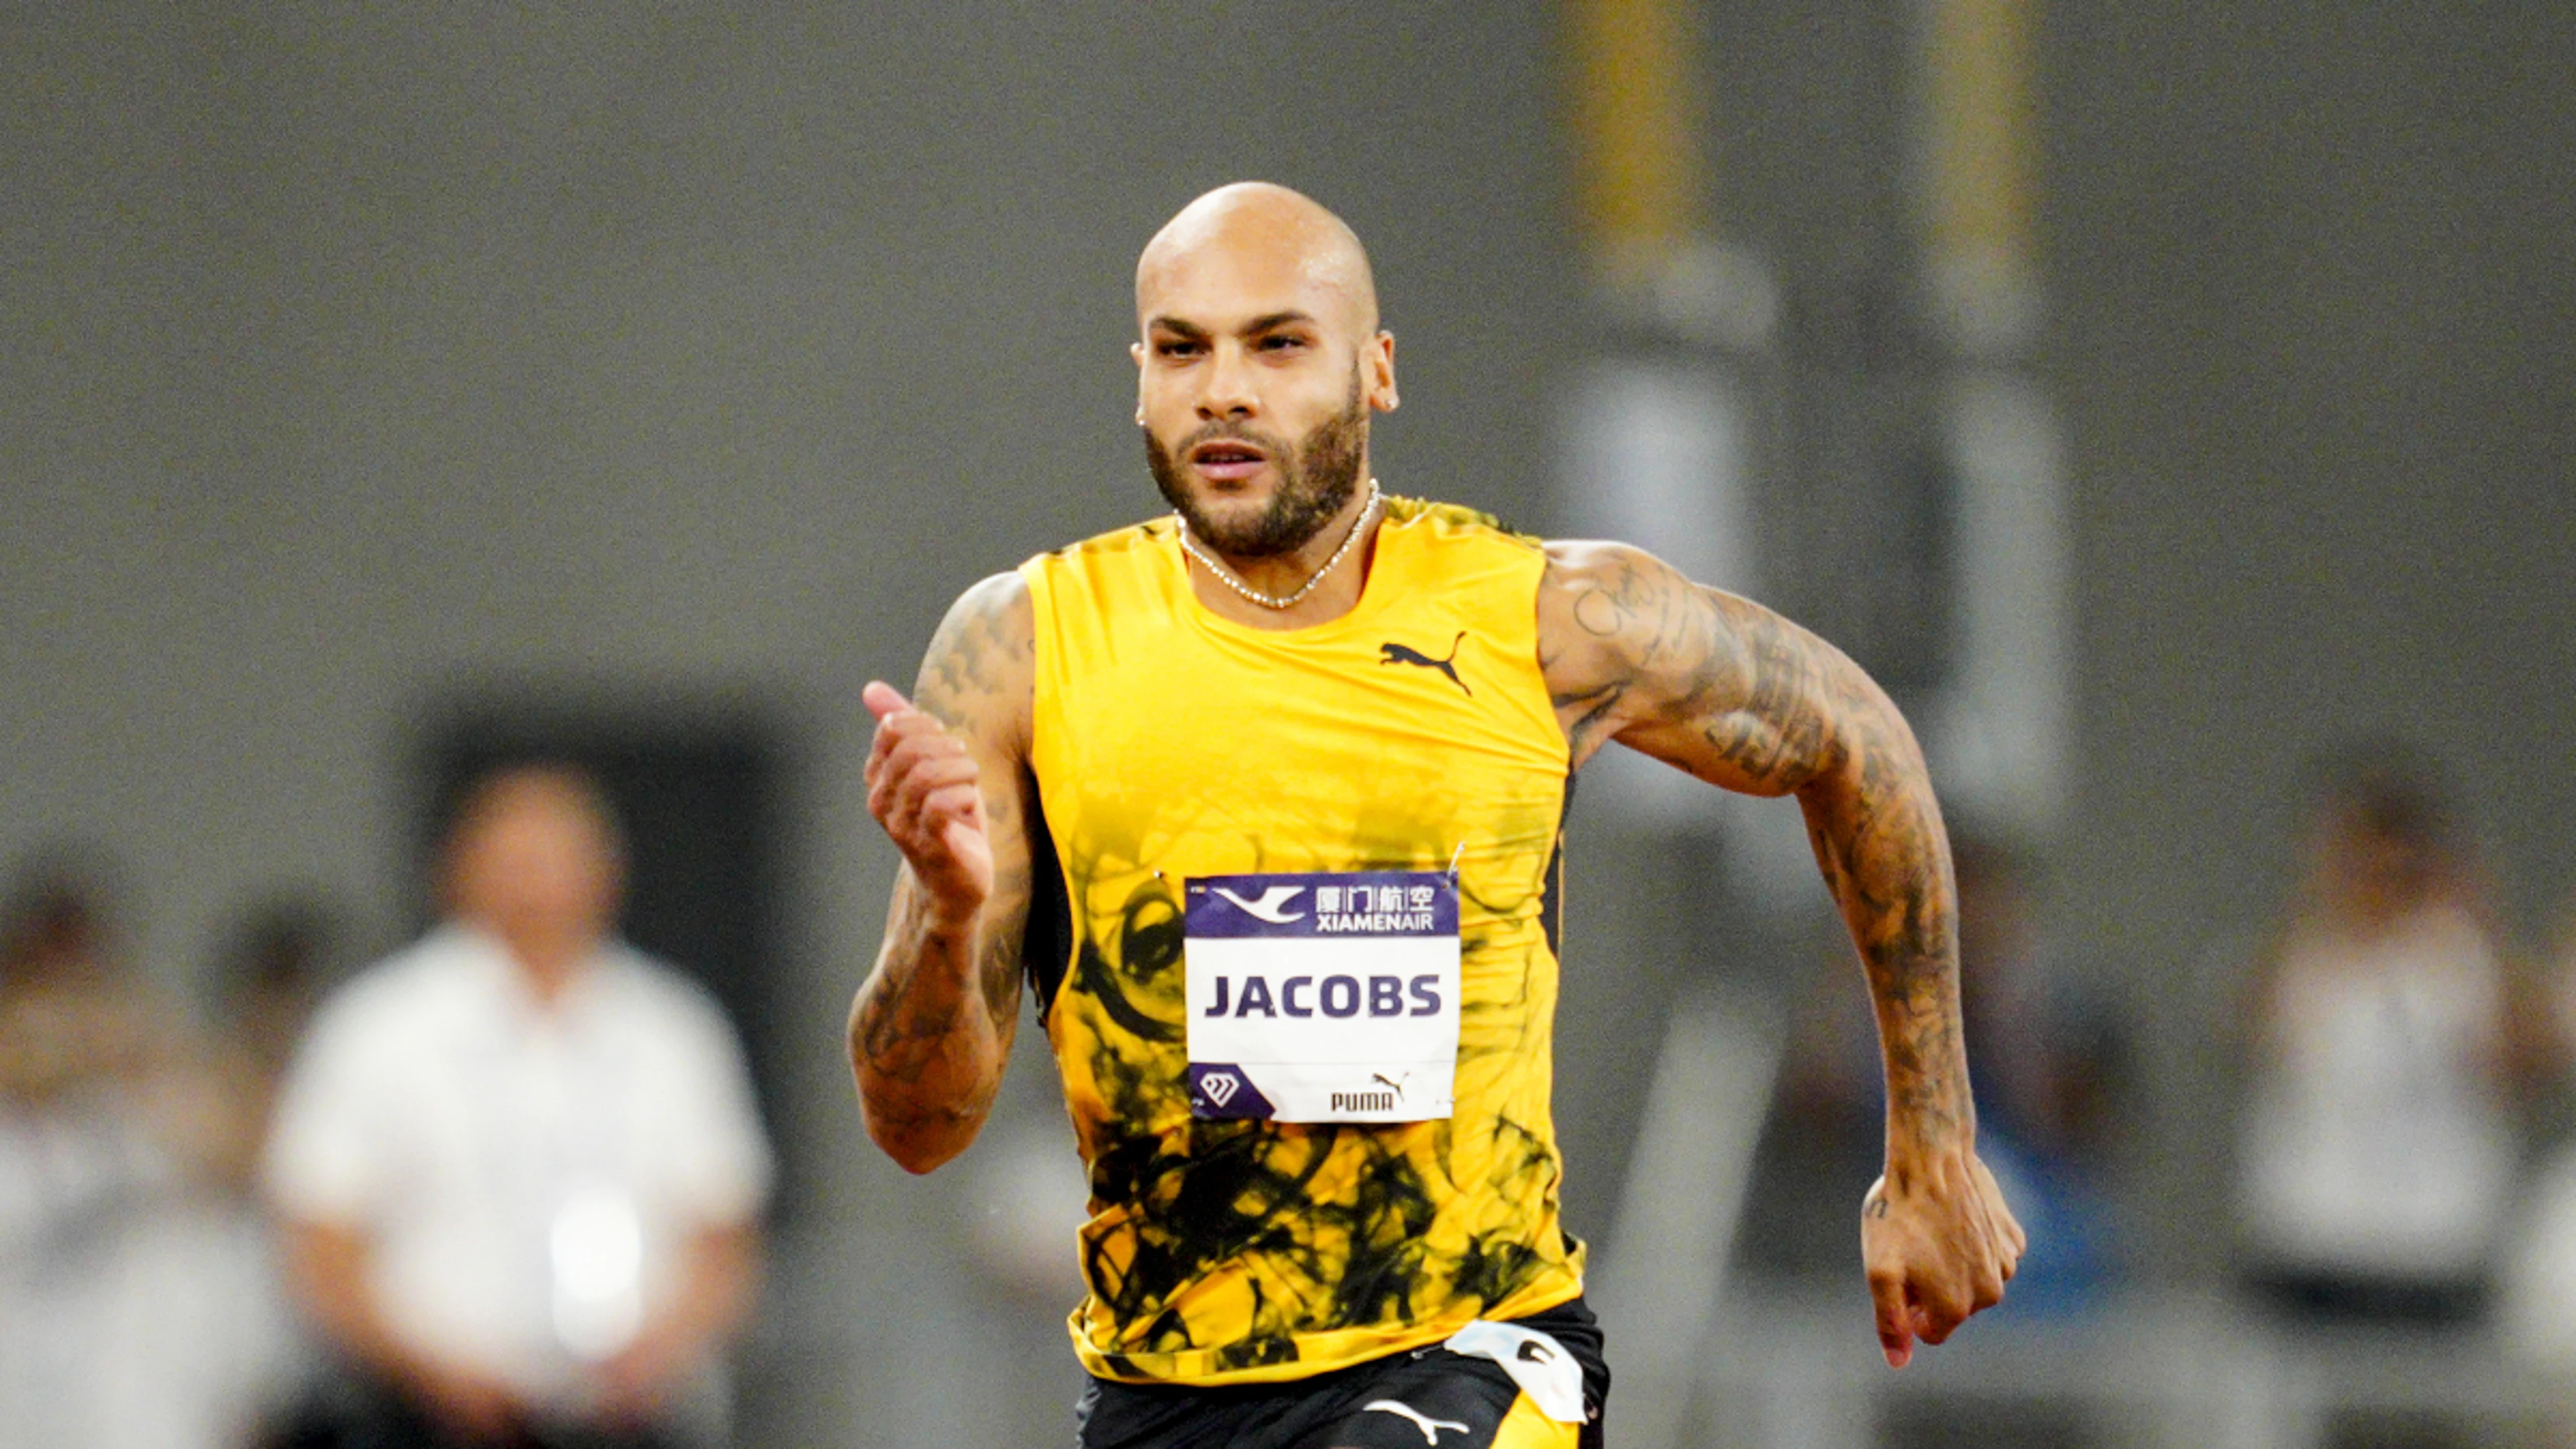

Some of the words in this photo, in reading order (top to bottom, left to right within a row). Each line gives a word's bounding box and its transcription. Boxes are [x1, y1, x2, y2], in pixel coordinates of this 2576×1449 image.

[1316, 913, 1434, 932] XIAMENAIR
[1204, 975, 1442, 1018] JACOBS
[1331, 1092, 1394, 1112] PUMA
